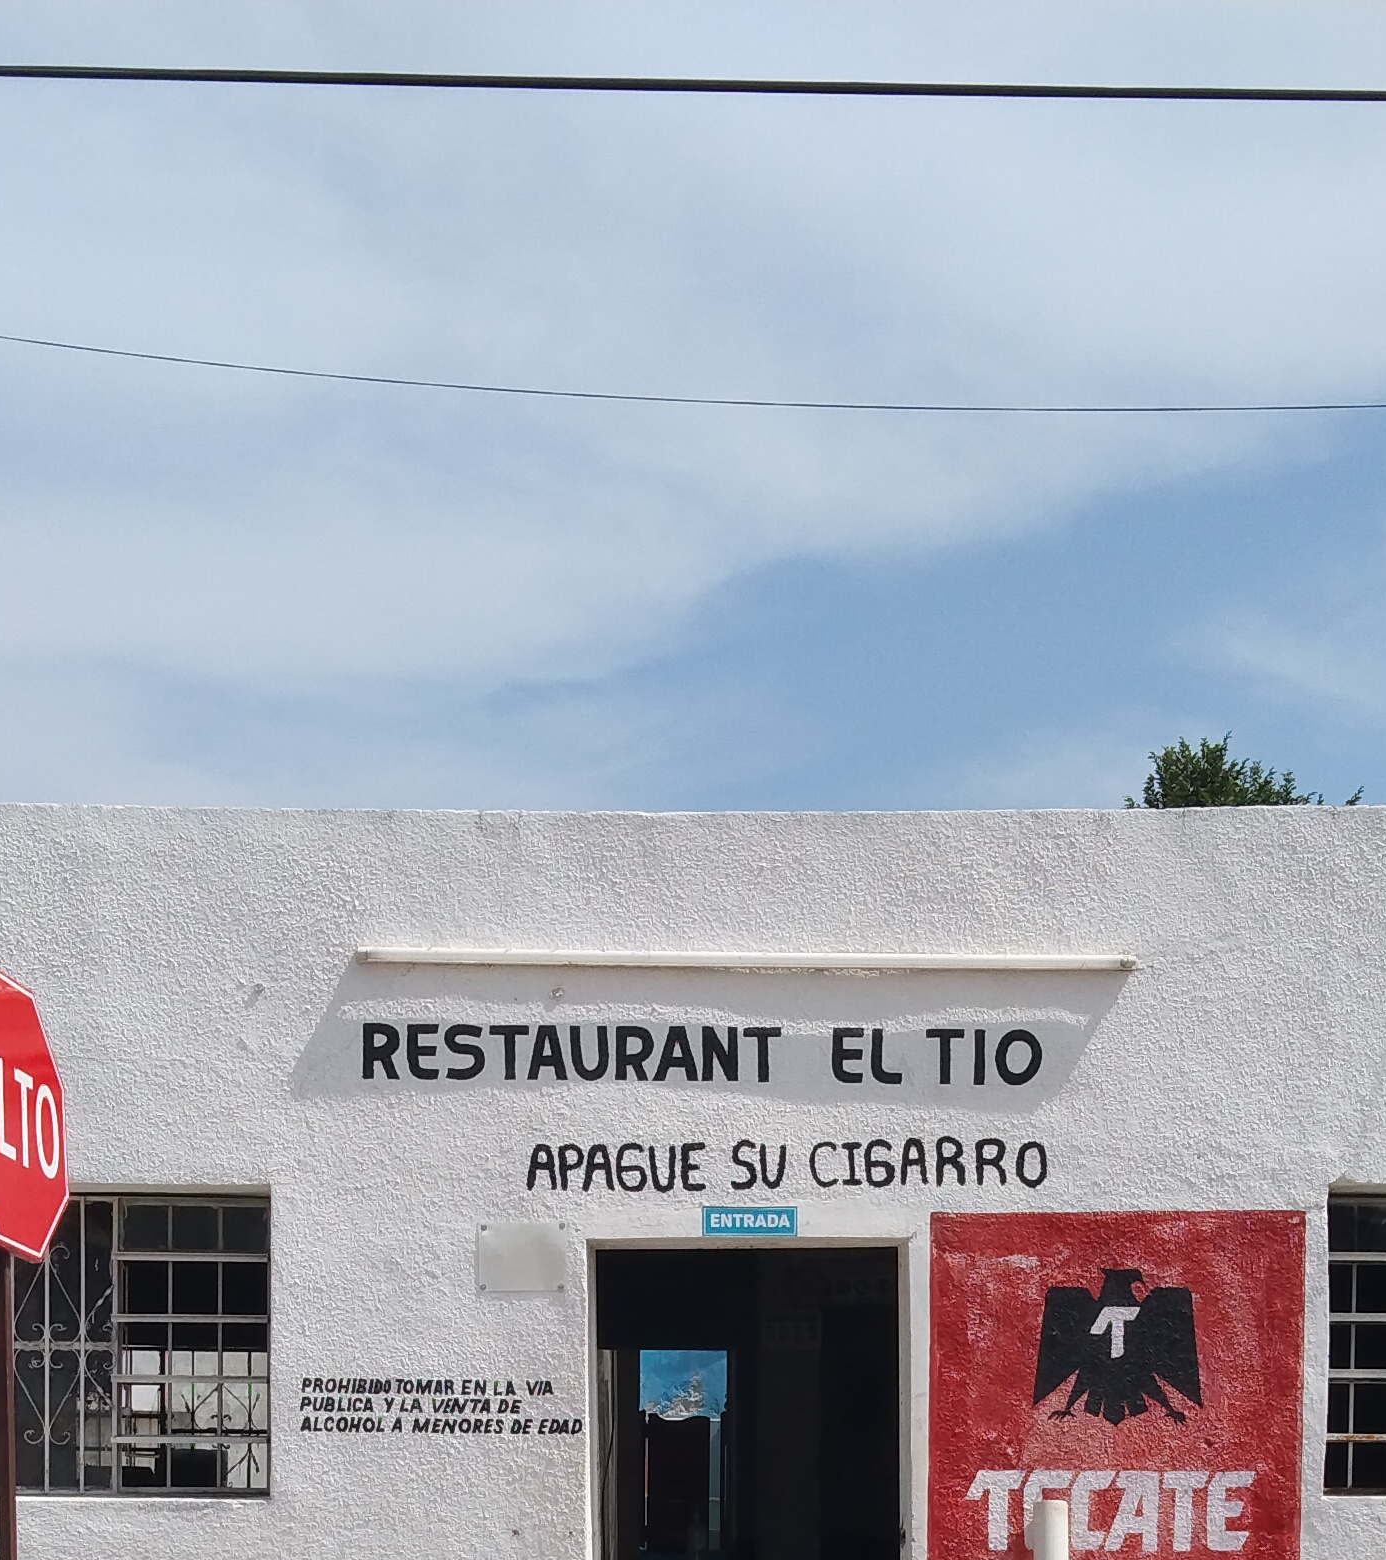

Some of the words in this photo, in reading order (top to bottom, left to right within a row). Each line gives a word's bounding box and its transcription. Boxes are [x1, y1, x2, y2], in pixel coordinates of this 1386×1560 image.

[361, 1022, 782, 1083] RESTAURANT
[830, 1027, 903, 1086] EL
[925, 1028, 1044, 1086] TIO
[525, 1140, 706, 1193] APAGUE
[731, 1138, 787, 1190] SU
[809, 1136, 1049, 1189] CIGARRO
[710, 1213, 791, 1228] ENTRADA
[301, 1377, 392, 1395] PROHIBIDO
[395, 1378, 455, 1396] TOMAR
[461, 1379, 488, 1396] EN
[494, 1380, 517, 1396] LA
[525, 1380, 555, 1396] VIA
[299, 1396, 374, 1413] PUBLICA
[385, 1398, 393, 1413] Y
[400, 1398, 423, 1413] LA
[432, 1398, 491, 1414] VENTA
[498, 1399, 523, 1414] DE
[300, 1416, 385, 1433] ALCOHOL
[391, 1417, 403, 1434] A
[412, 1418, 504, 1435] MENORES
[510, 1418, 533, 1435] DE
[538, 1418, 584, 1436] EDAD
